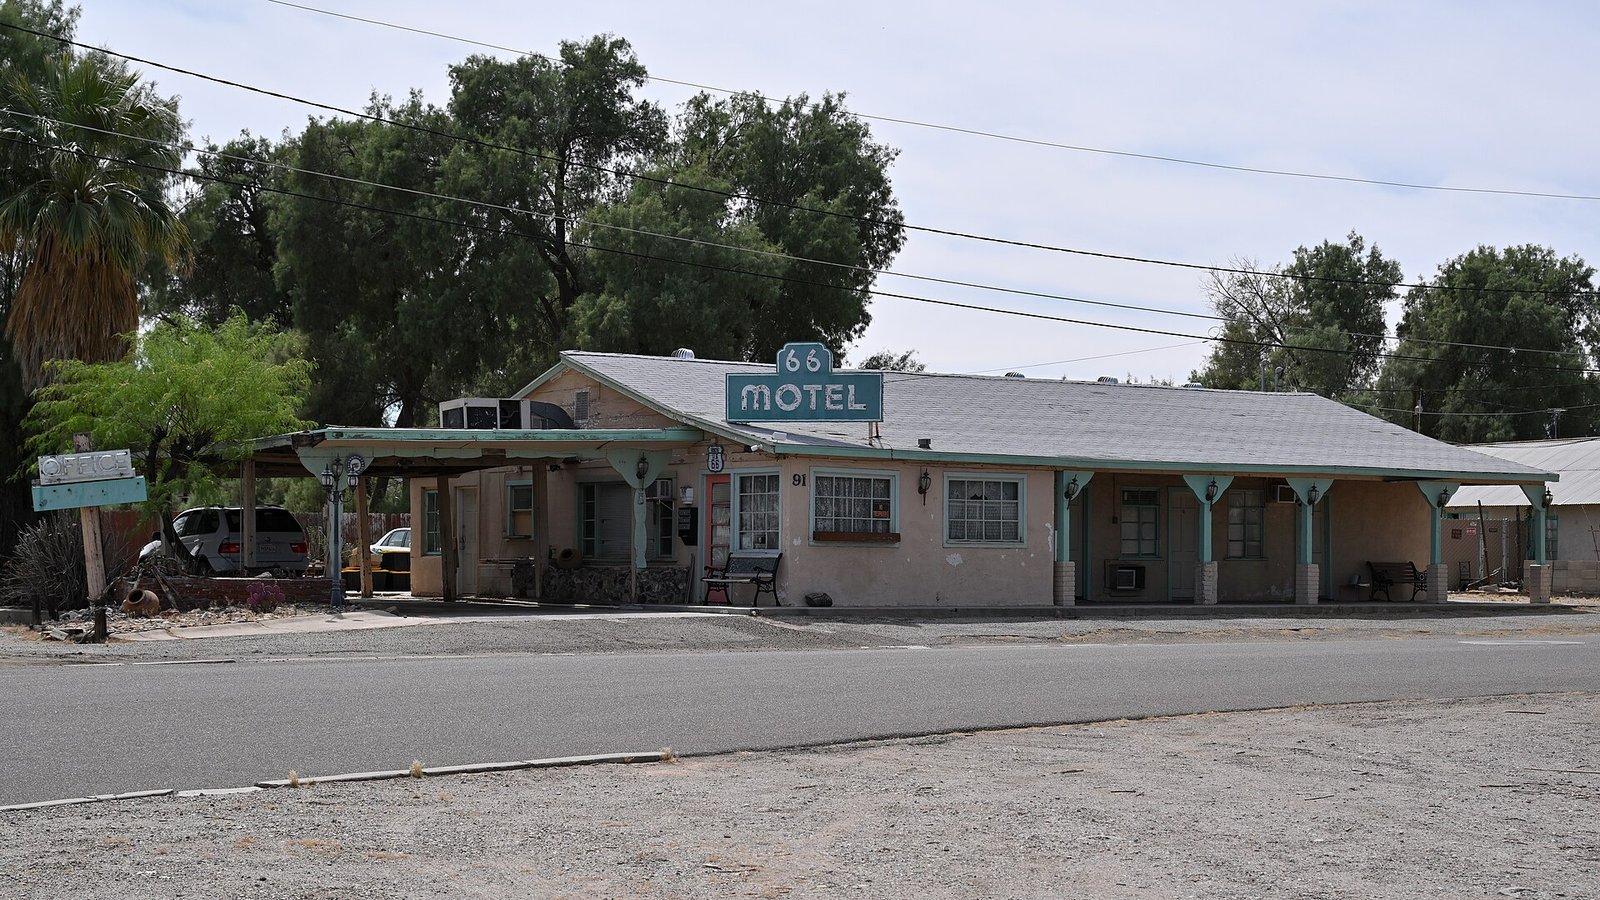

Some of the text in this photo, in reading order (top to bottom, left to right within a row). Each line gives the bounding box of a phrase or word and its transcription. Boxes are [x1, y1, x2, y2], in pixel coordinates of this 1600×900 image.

[786, 349, 821, 372] 66
[741, 383, 867, 411] MOTEL
[42, 452, 127, 476] OFFICE
[711, 459, 720, 469] 66
[792, 473, 807, 486] 91
